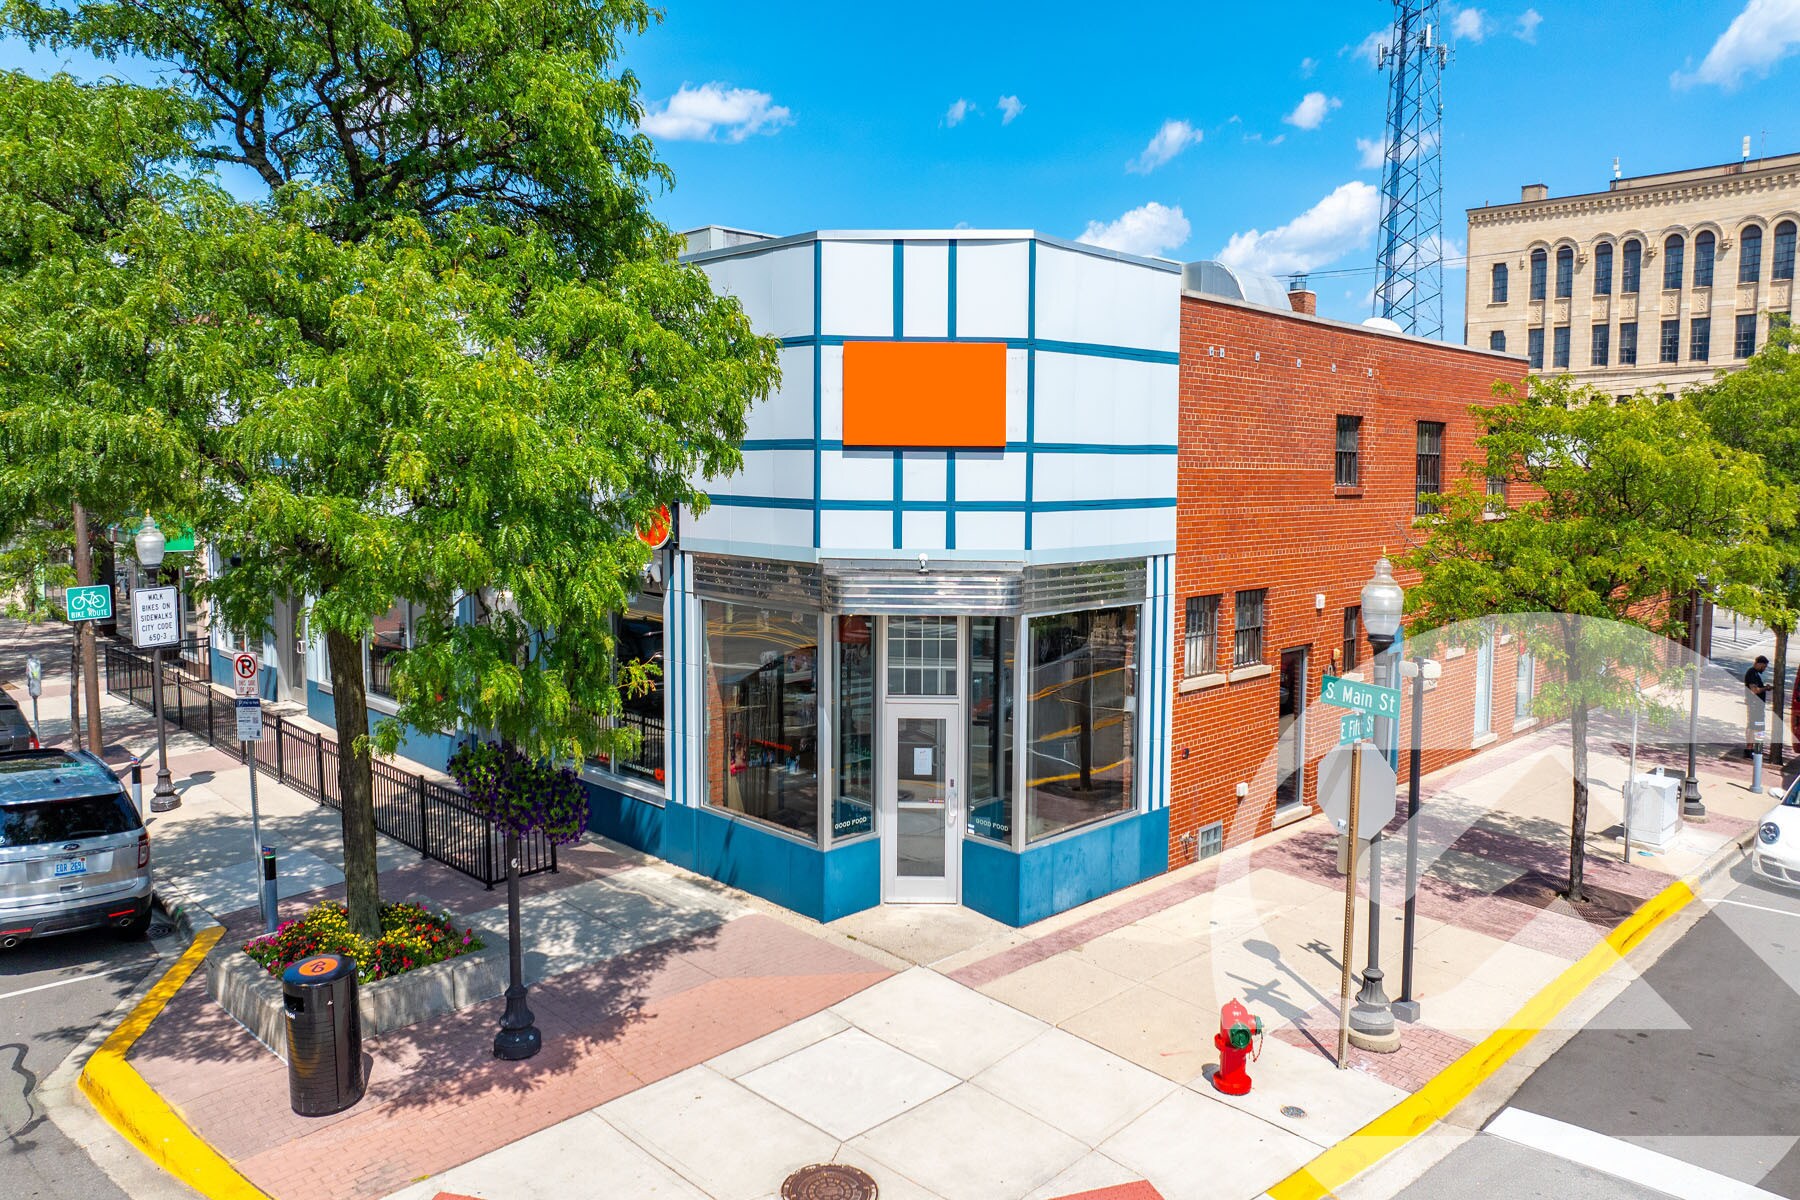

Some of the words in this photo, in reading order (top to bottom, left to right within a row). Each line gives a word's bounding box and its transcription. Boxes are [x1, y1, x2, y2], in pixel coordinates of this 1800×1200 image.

[147, 593, 164, 601] WALK
[141, 604, 159, 612] BIKES
[162, 602, 171, 610] ON
[71, 611, 85, 619] BIKE
[88, 609, 108, 617] ROUTE
[140, 612, 173, 622] SIDEWALKS
[141, 624, 154, 632] CITY
[157, 622, 173, 630] CODE
[148, 633, 167, 641] 650-3
[1326, 682, 1336, 700] S.
[1342, 685, 1373, 708] Main
[1379, 693, 1396, 713] St
[1340, 722, 1347, 740] E
[1349, 718, 1363, 738] Fift
[1366, 715, 1374, 733] St
[834, 820, 851, 830] GOOD
[851, 816, 867, 826] FOOD
[975, 817, 992, 827] GOOD
[992, 822, 1009, 832] FOOD
